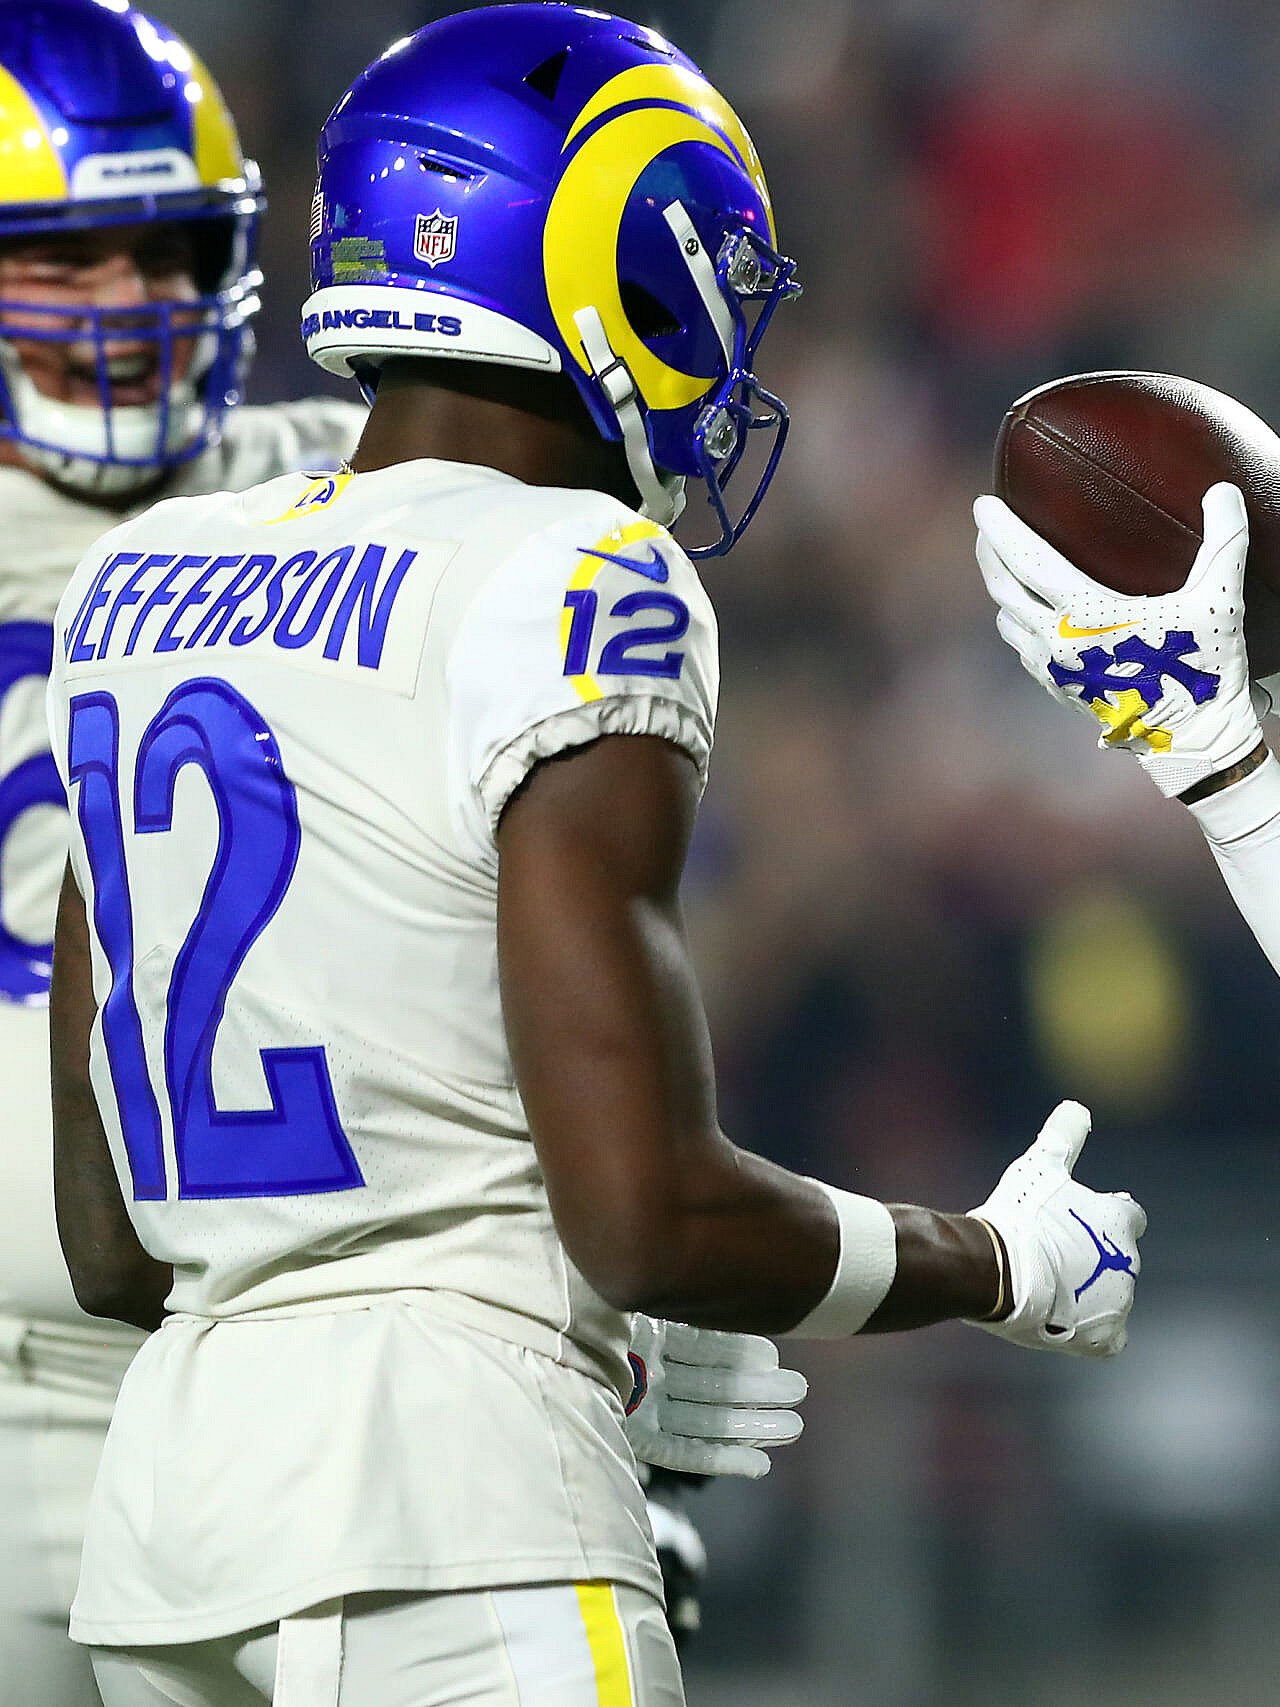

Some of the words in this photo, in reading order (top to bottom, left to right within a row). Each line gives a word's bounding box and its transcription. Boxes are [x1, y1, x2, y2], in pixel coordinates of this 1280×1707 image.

[418, 233, 450, 257] NFL
[322, 308, 463, 337] ANGELES
[63, 543, 419, 671] JEFFERSON
[562, 589, 690, 680] 12
[68, 676, 367, 1201] 12
